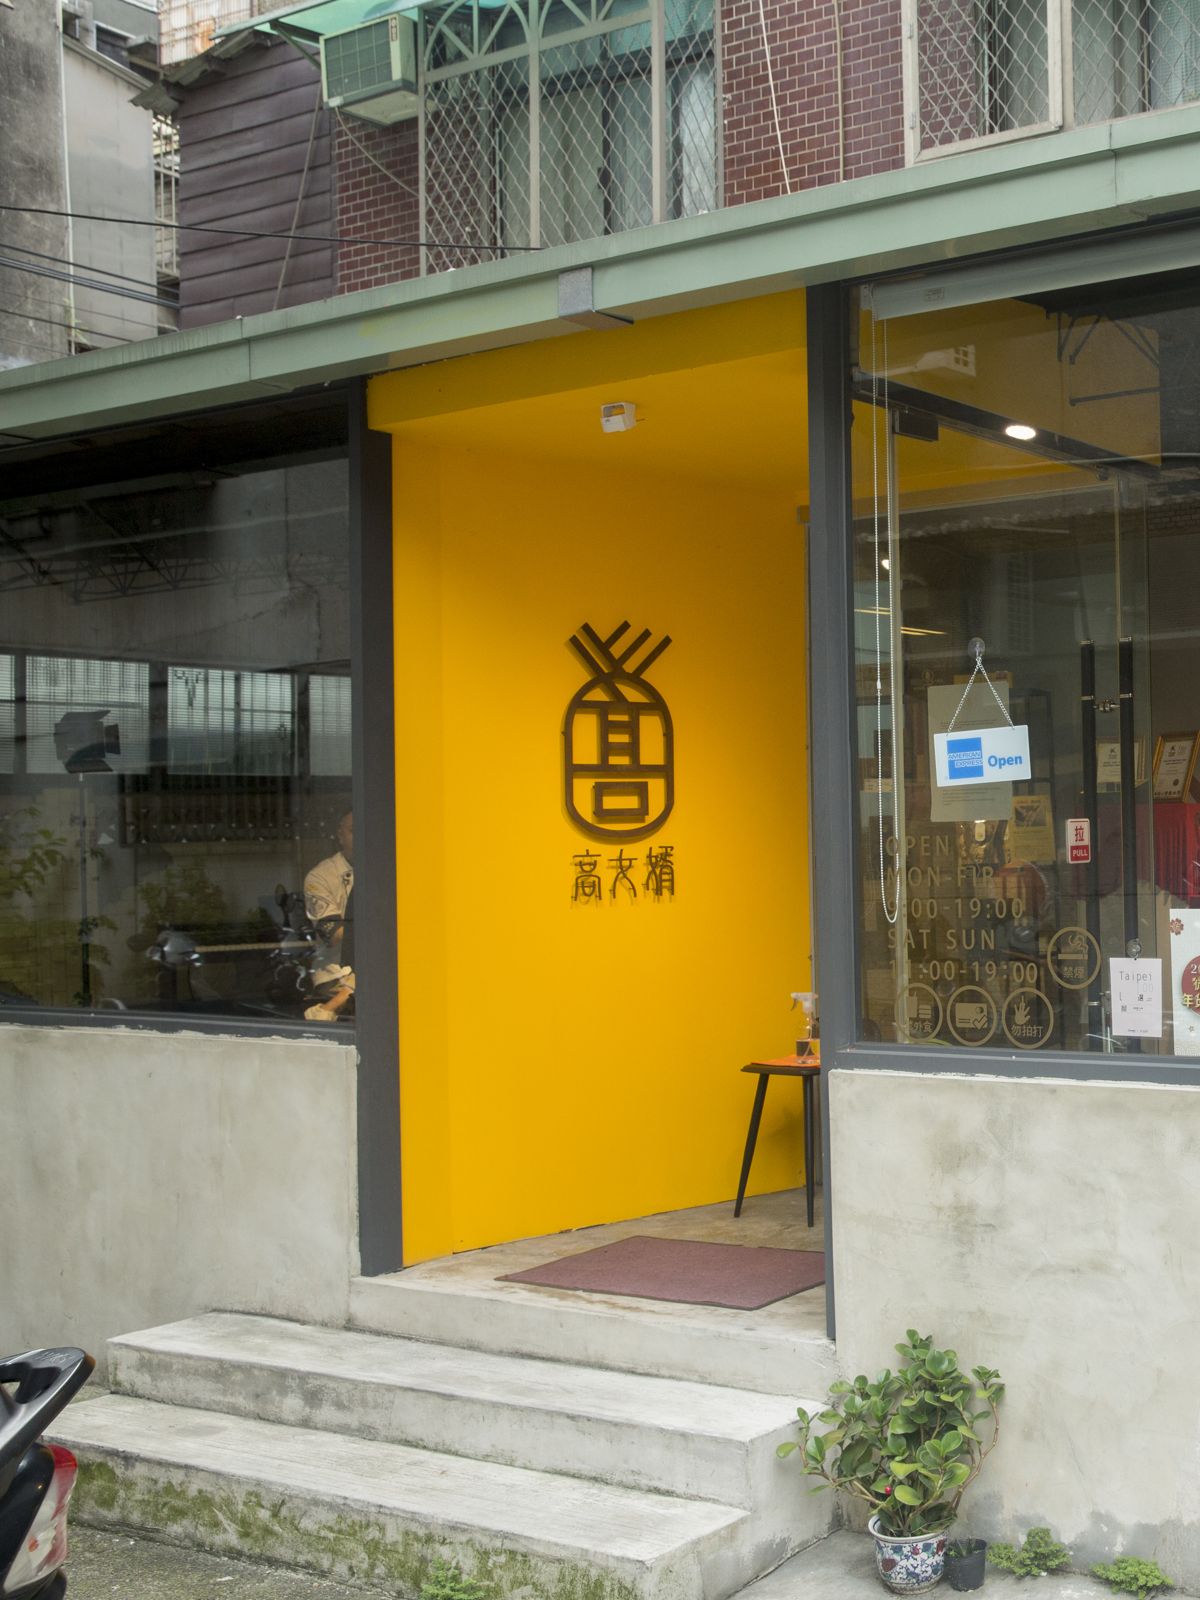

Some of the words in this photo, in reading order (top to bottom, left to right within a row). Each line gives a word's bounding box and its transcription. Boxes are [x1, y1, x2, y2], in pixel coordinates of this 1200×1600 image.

[955, 759, 984, 768] EXPRESS
[988, 754, 1023, 769] Open
[1074, 825, 1085, 842] 拉
[886, 835, 949, 856] OPEN
[1072, 849, 1088, 857] PULL
[571, 846, 675, 901] 高女婿
[887, 866, 994, 887] MON-FIR
[887, 928, 931, 950] SAT
[946, 929, 995, 951] SUN
[1119, 970, 1153, 984] Taipei
